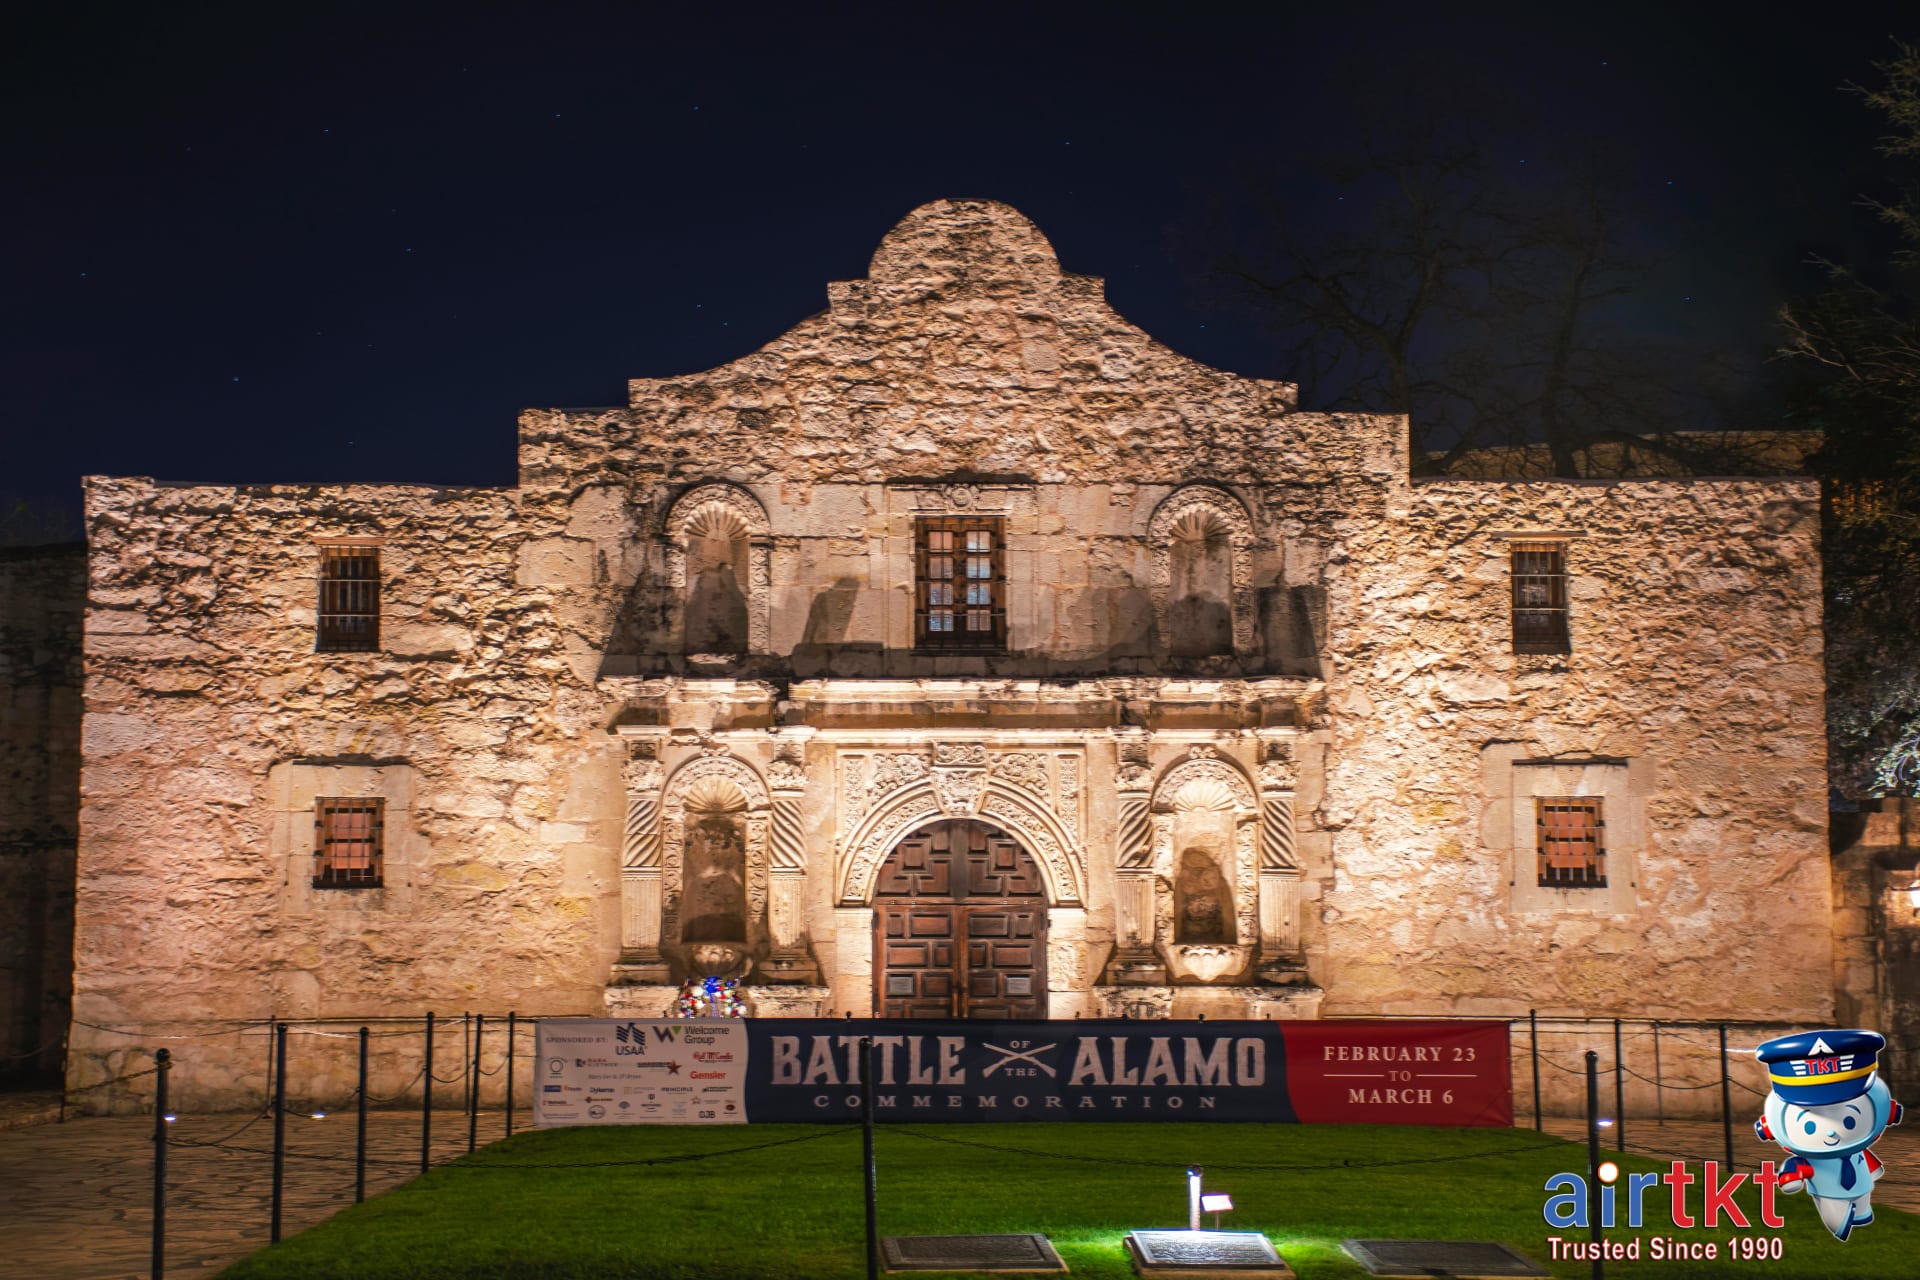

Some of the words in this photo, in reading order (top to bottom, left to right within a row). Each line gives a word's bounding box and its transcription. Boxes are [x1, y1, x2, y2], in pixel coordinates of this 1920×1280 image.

[684, 1025, 730, 1035] Welcome
[684, 1035, 715, 1046] Group
[1010, 1039, 1031, 1049] OF
[615, 1046, 645, 1056] USAA
[1323, 1045, 1443, 1062] FEBRUARY
[1453, 1047, 1476, 1062] 23
[769, 1035, 966, 1086] BATTLE
[1068, 1036, 1265, 1087] ALAMO
[1005, 1067, 1037, 1077] THE
[1388, 1070, 1411, 1082] TO
[814, 1095, 1217, 1108] COMMEMORATION
[1348, 1088, 1433, 1104] MARCH
[1442, 1089, 1454, 1105] 6
